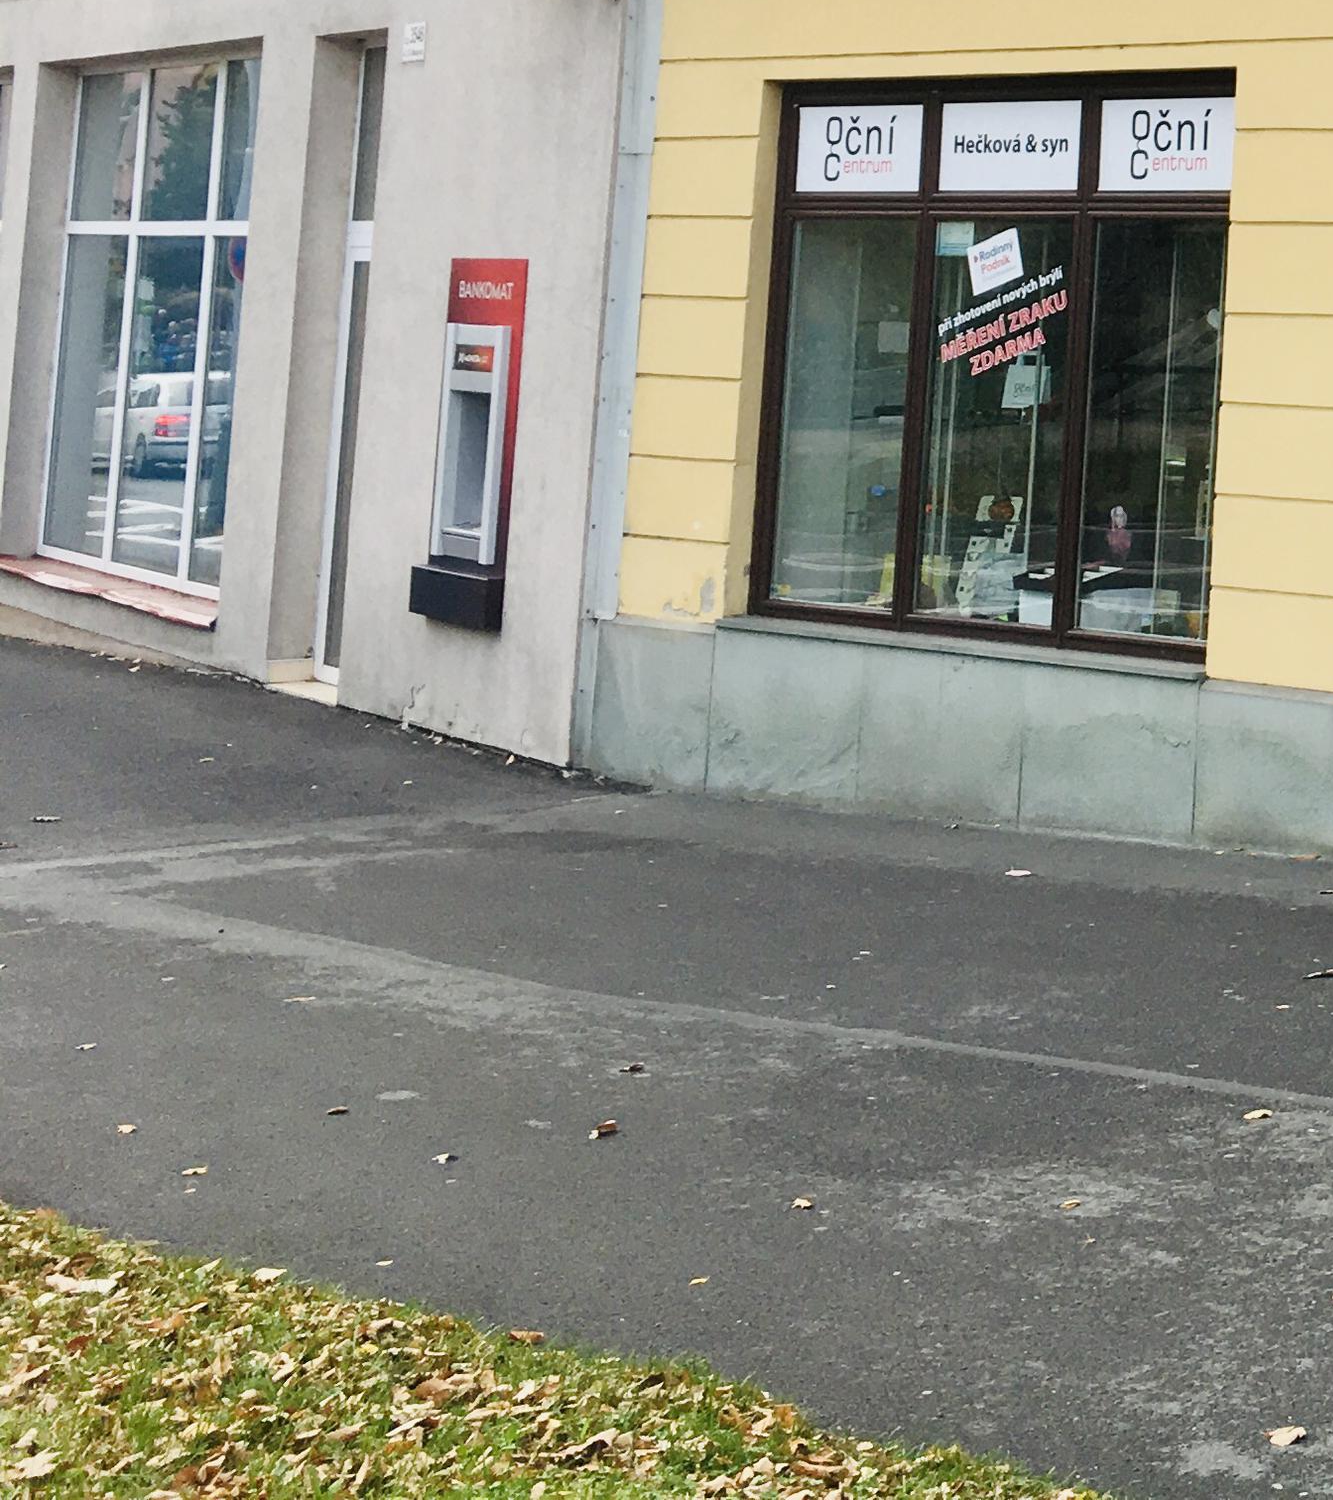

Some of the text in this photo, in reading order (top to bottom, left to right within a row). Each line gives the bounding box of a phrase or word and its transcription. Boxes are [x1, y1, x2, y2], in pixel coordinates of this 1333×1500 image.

[953, 134, 1069, 155] Hečková & syn
[458, 280, 515, 300] BANKOMAT
[953, 293, 1002, 327] zhotovení
[1002, 279, 1039, 304] nových
[939, 289, 1069, 364] MĚŘENÍ ZRAKU
[969, 327, 1047, 377] ZDARMA
